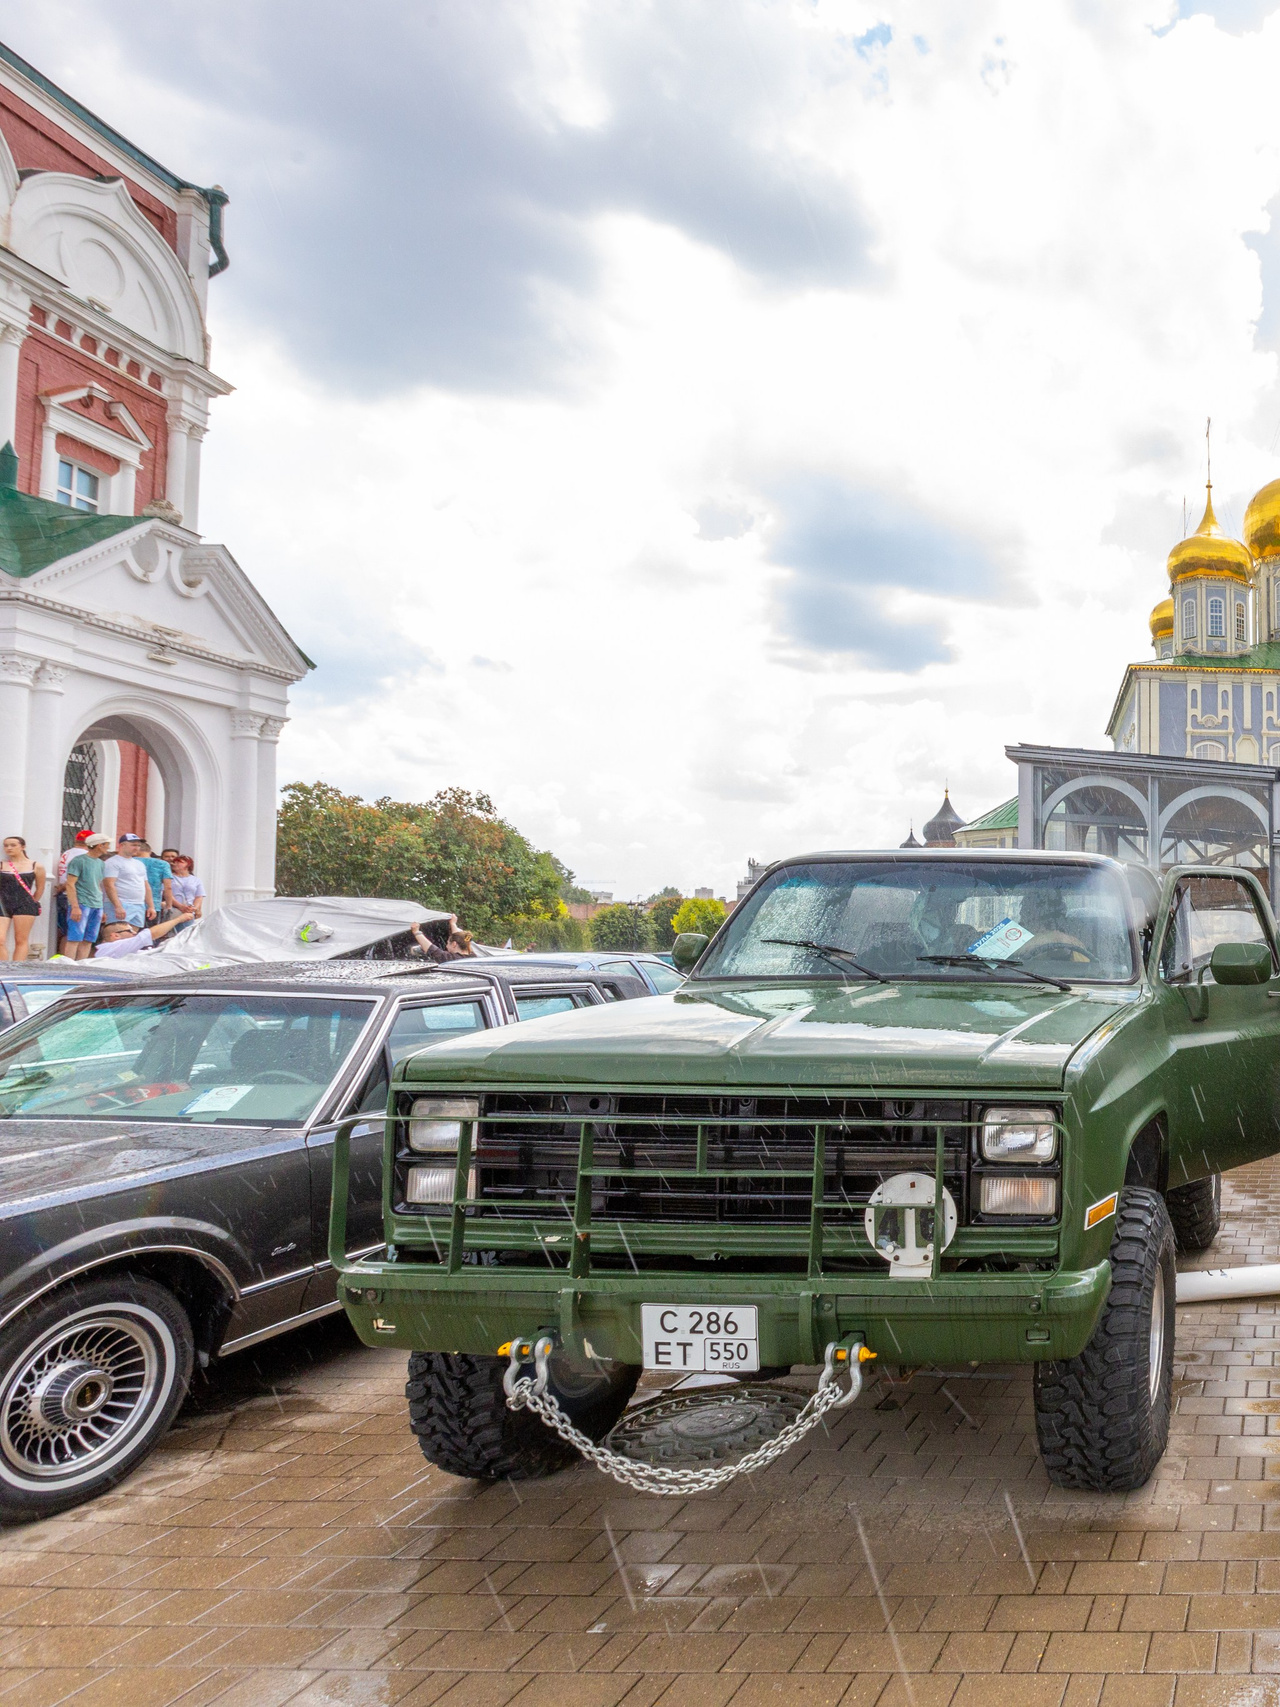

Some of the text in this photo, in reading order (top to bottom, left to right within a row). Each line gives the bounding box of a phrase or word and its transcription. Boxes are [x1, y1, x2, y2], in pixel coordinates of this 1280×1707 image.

[974, 933, 991, 948] ТУЛА
[689, 1311, 739, 1335] 286
[710, 1342, 748, 1361] 550
[722, 1362, 740, 1370] RUS
